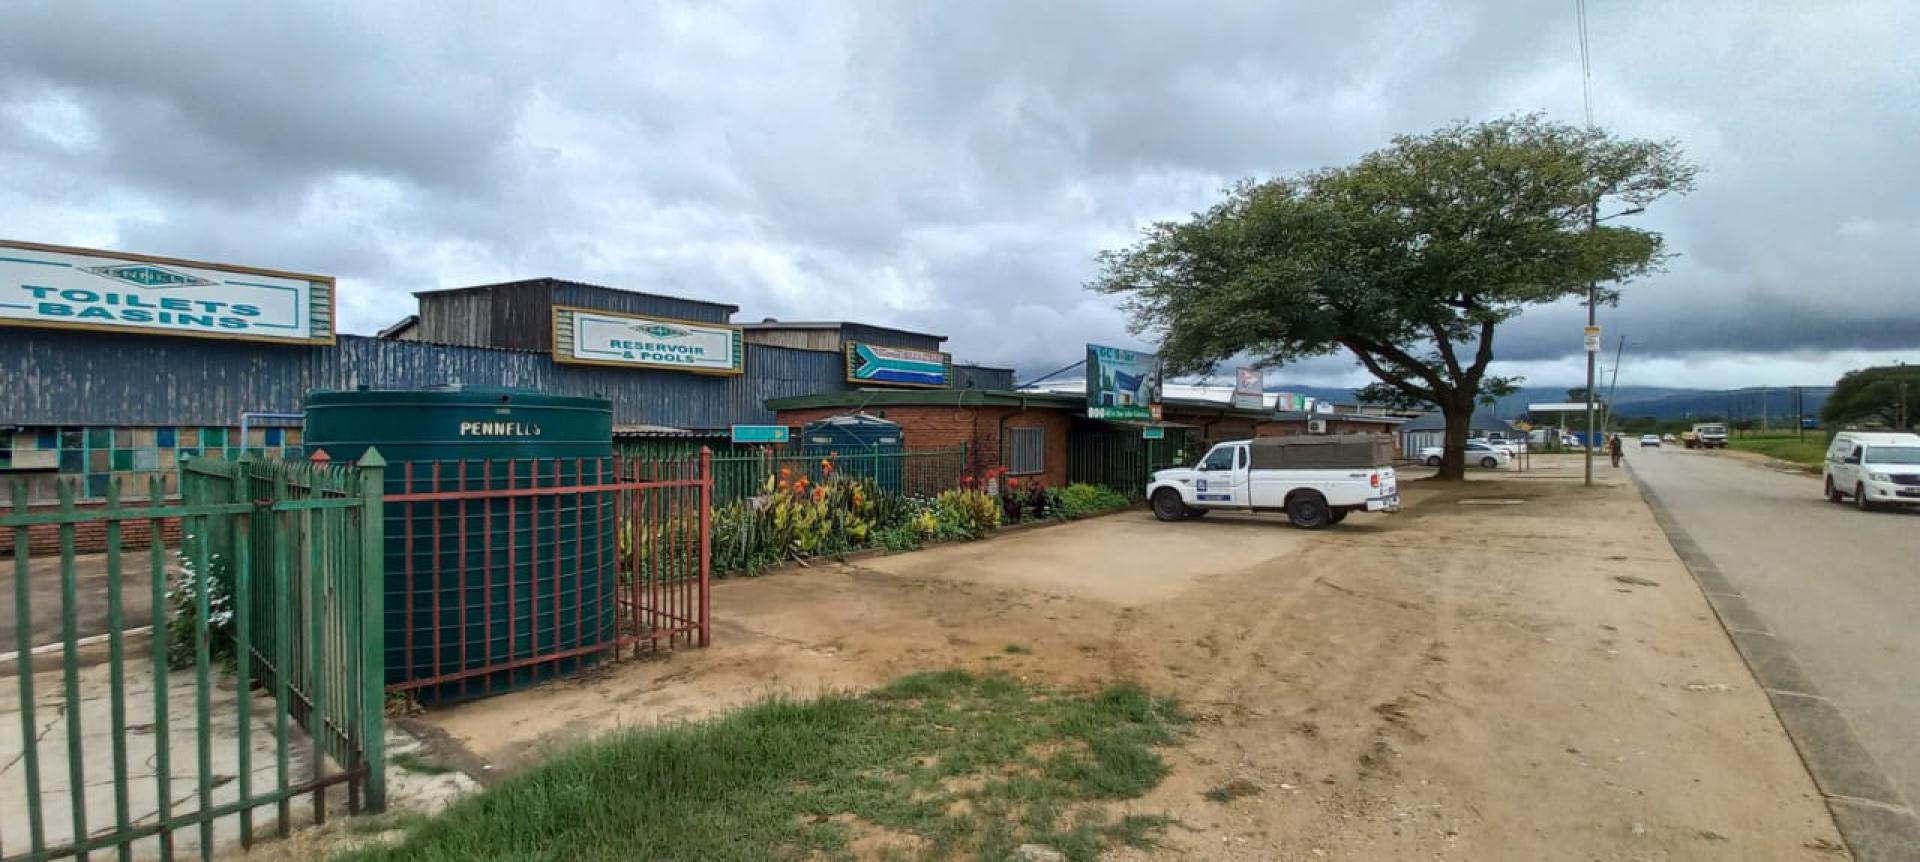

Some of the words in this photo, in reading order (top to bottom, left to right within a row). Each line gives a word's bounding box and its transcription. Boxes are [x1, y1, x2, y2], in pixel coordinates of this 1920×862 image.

[21, 284, 261, 316] TOILETS
[37, 302, 250, 329] BASINS
[610, 339, 704, 355] RESERVOIR
[623, 350, 634, 359] &
[641, 351, 694, 363] POOLS
[461, 422, 540, 436] PENNELLS
